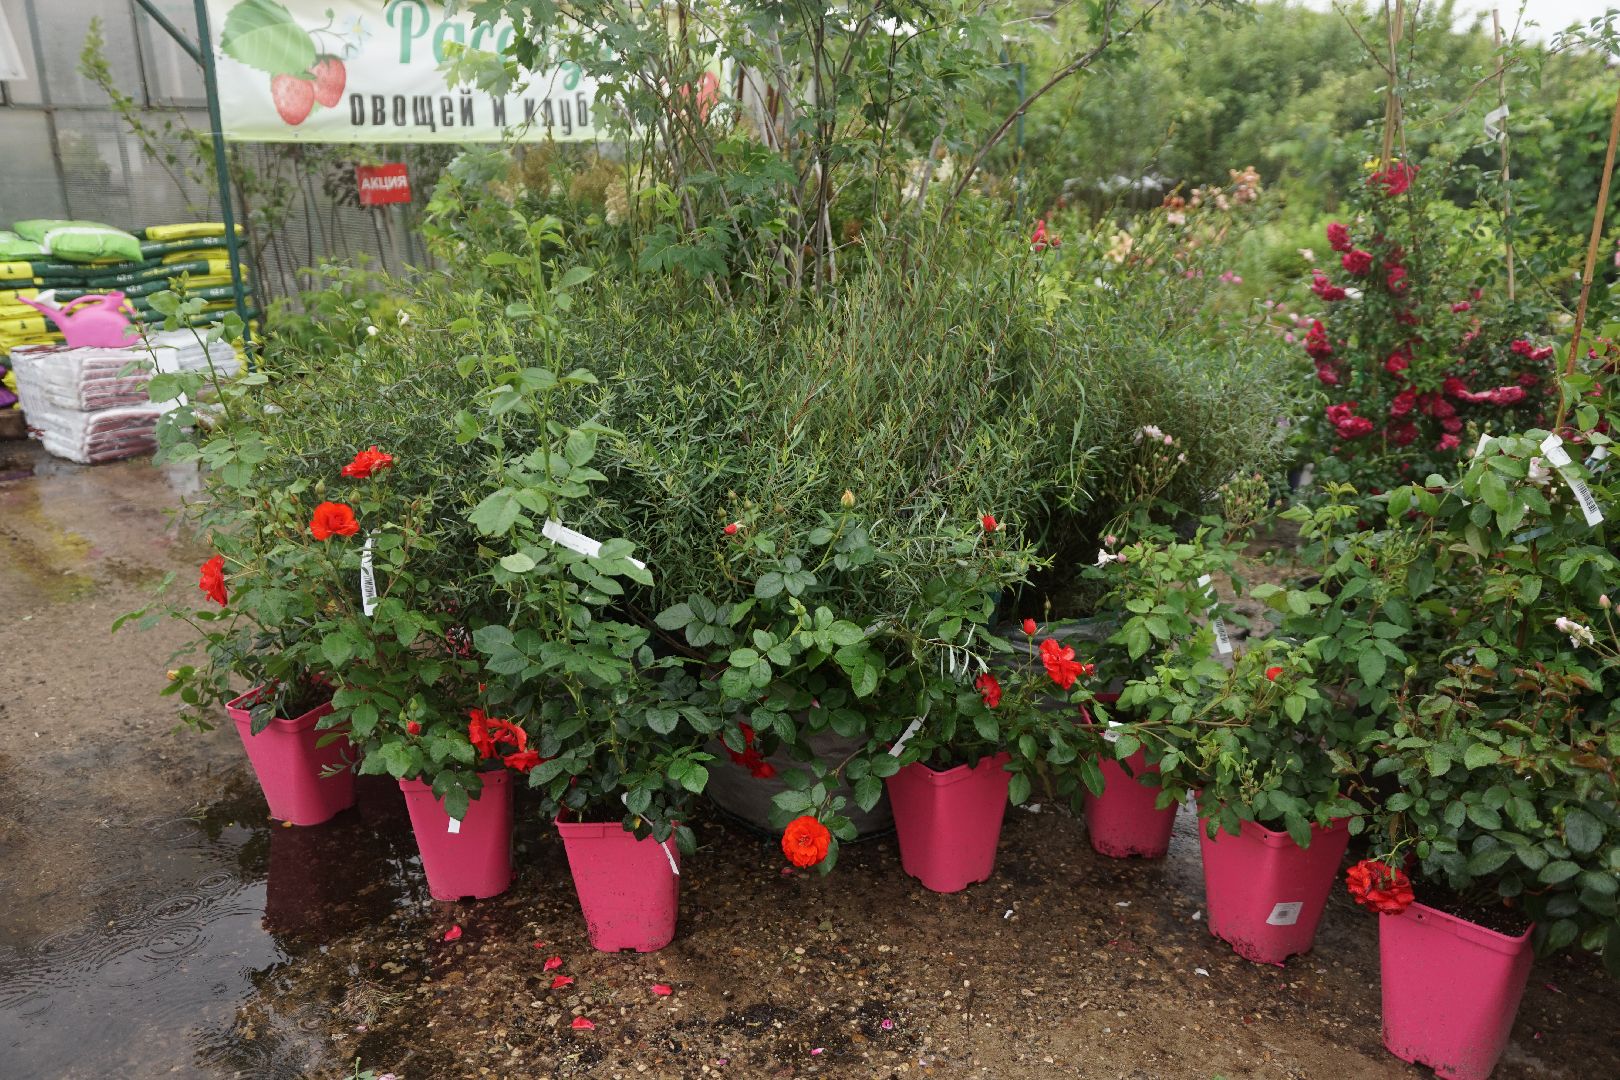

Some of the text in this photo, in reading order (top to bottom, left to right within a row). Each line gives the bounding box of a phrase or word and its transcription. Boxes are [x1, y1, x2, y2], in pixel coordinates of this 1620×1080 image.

[349, 88, 588, 135] овощей и клуб
[361, 175, 408, 191] АКЦИЯ
